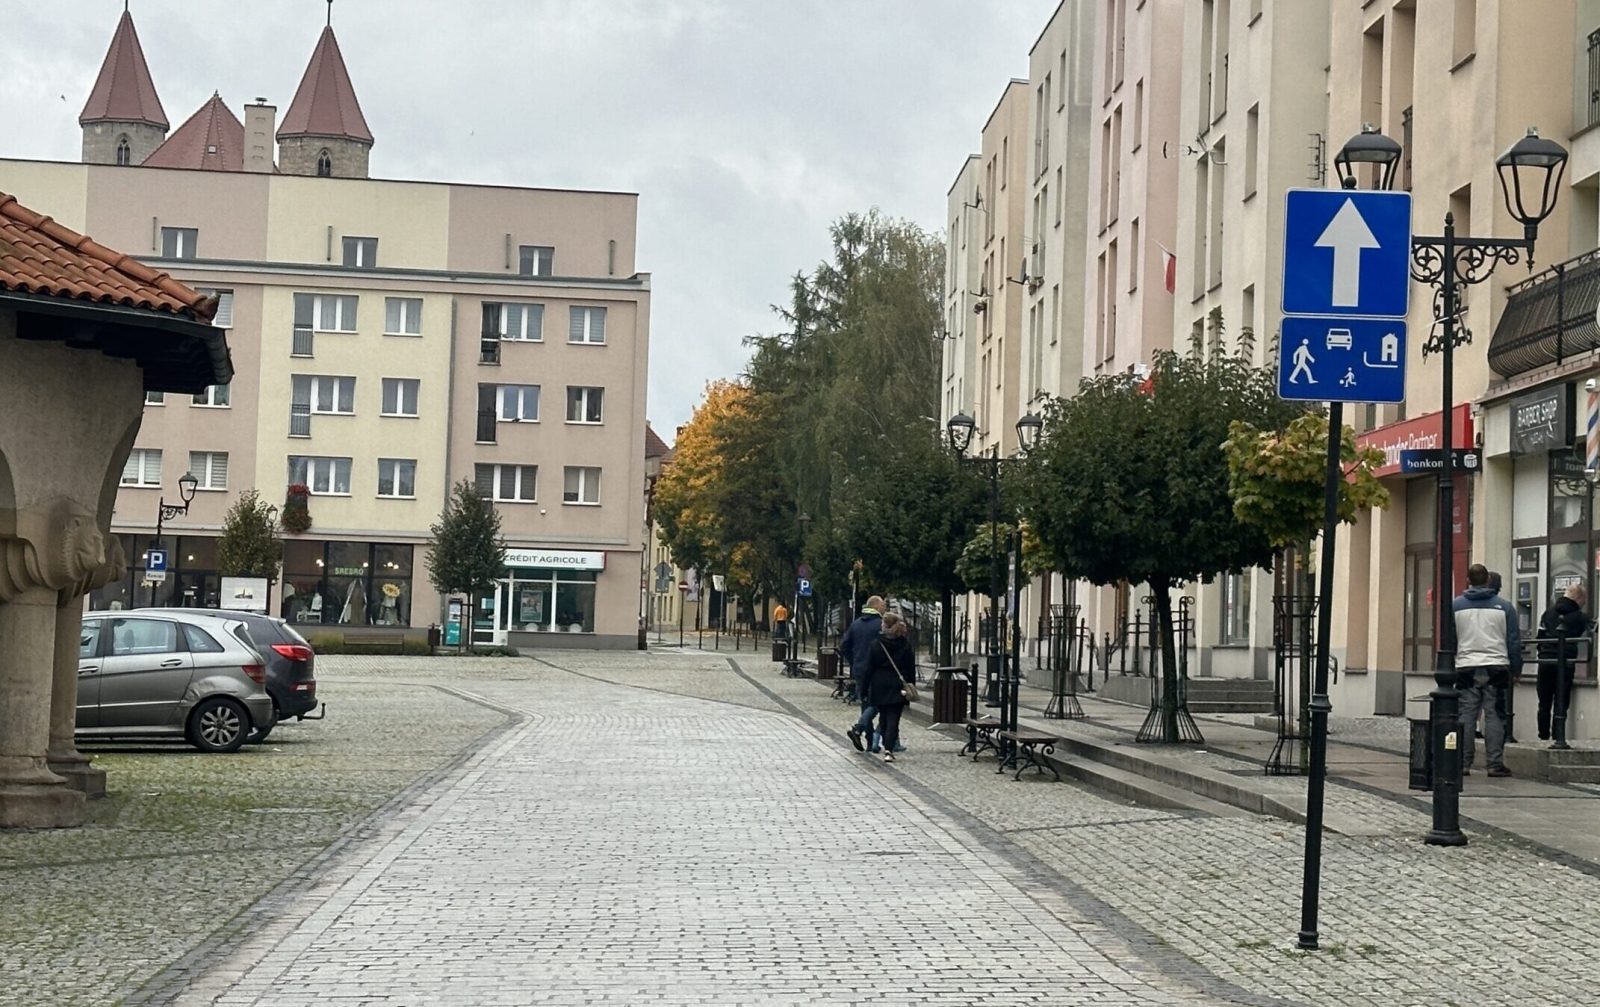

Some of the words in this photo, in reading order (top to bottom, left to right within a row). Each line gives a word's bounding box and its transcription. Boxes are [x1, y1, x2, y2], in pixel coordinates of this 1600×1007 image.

[1517, 404, 1541, 428] BARBER
[1541, 399, 1558, 421] SHOP
[1407, 457, 1457, 469] bankomt
[150, 552, 163, 568] P
[540, 556, 587, 565] AGRICOLE
[801, 580, 810, 591] P
